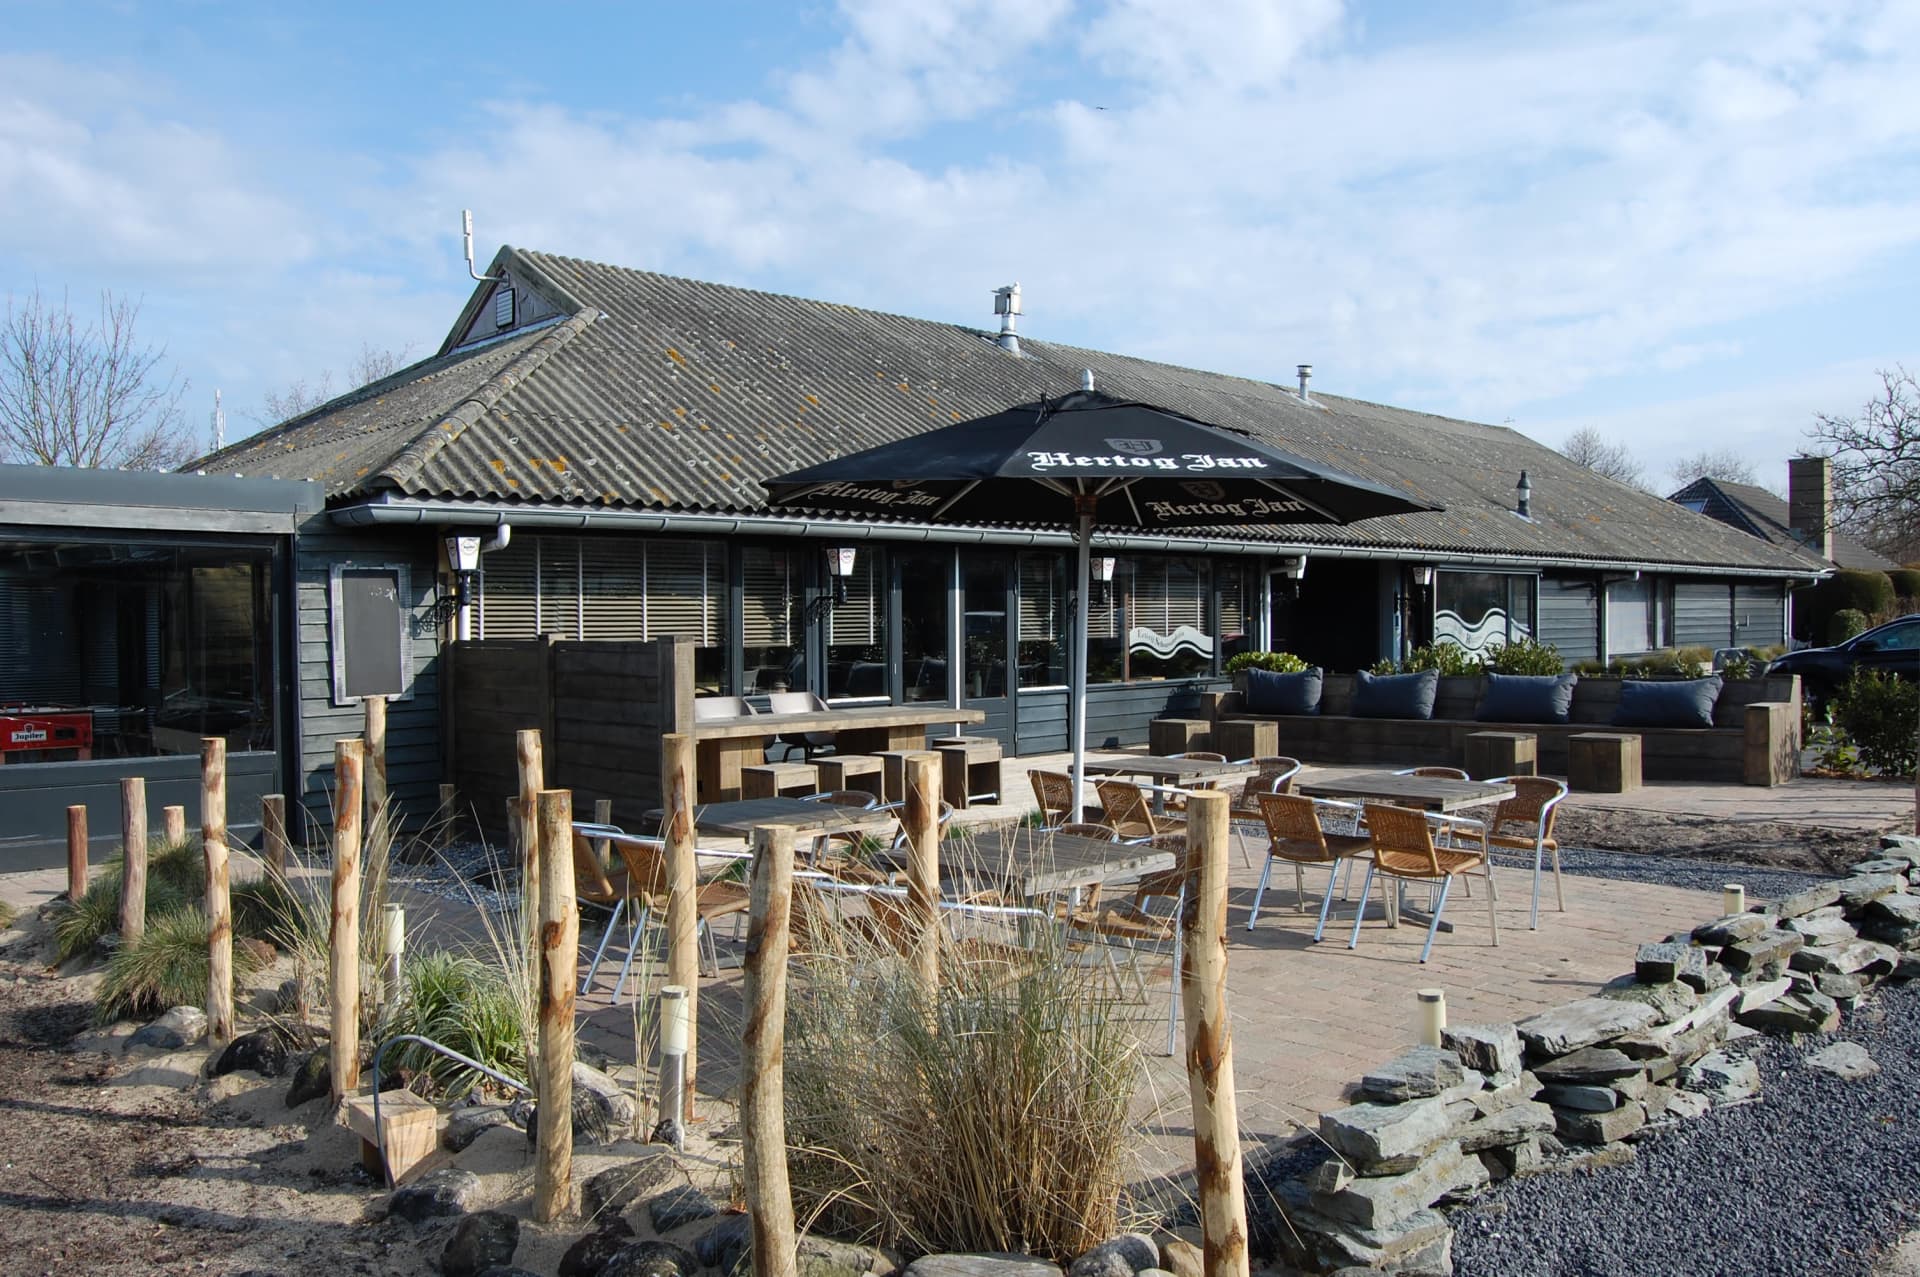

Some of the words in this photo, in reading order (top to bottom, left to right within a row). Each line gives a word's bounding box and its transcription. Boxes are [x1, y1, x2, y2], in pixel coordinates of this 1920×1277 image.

[1027, 451, 1180, 471] Hertog
[1181, 454, 1268, 472] Jan
[808, 481, 899, 504] Hertog
[889, 490, 941, 507] Jan
[1145, 501, 1247, 521] Hertog
[1243, 498, 1306, 518] Jan
